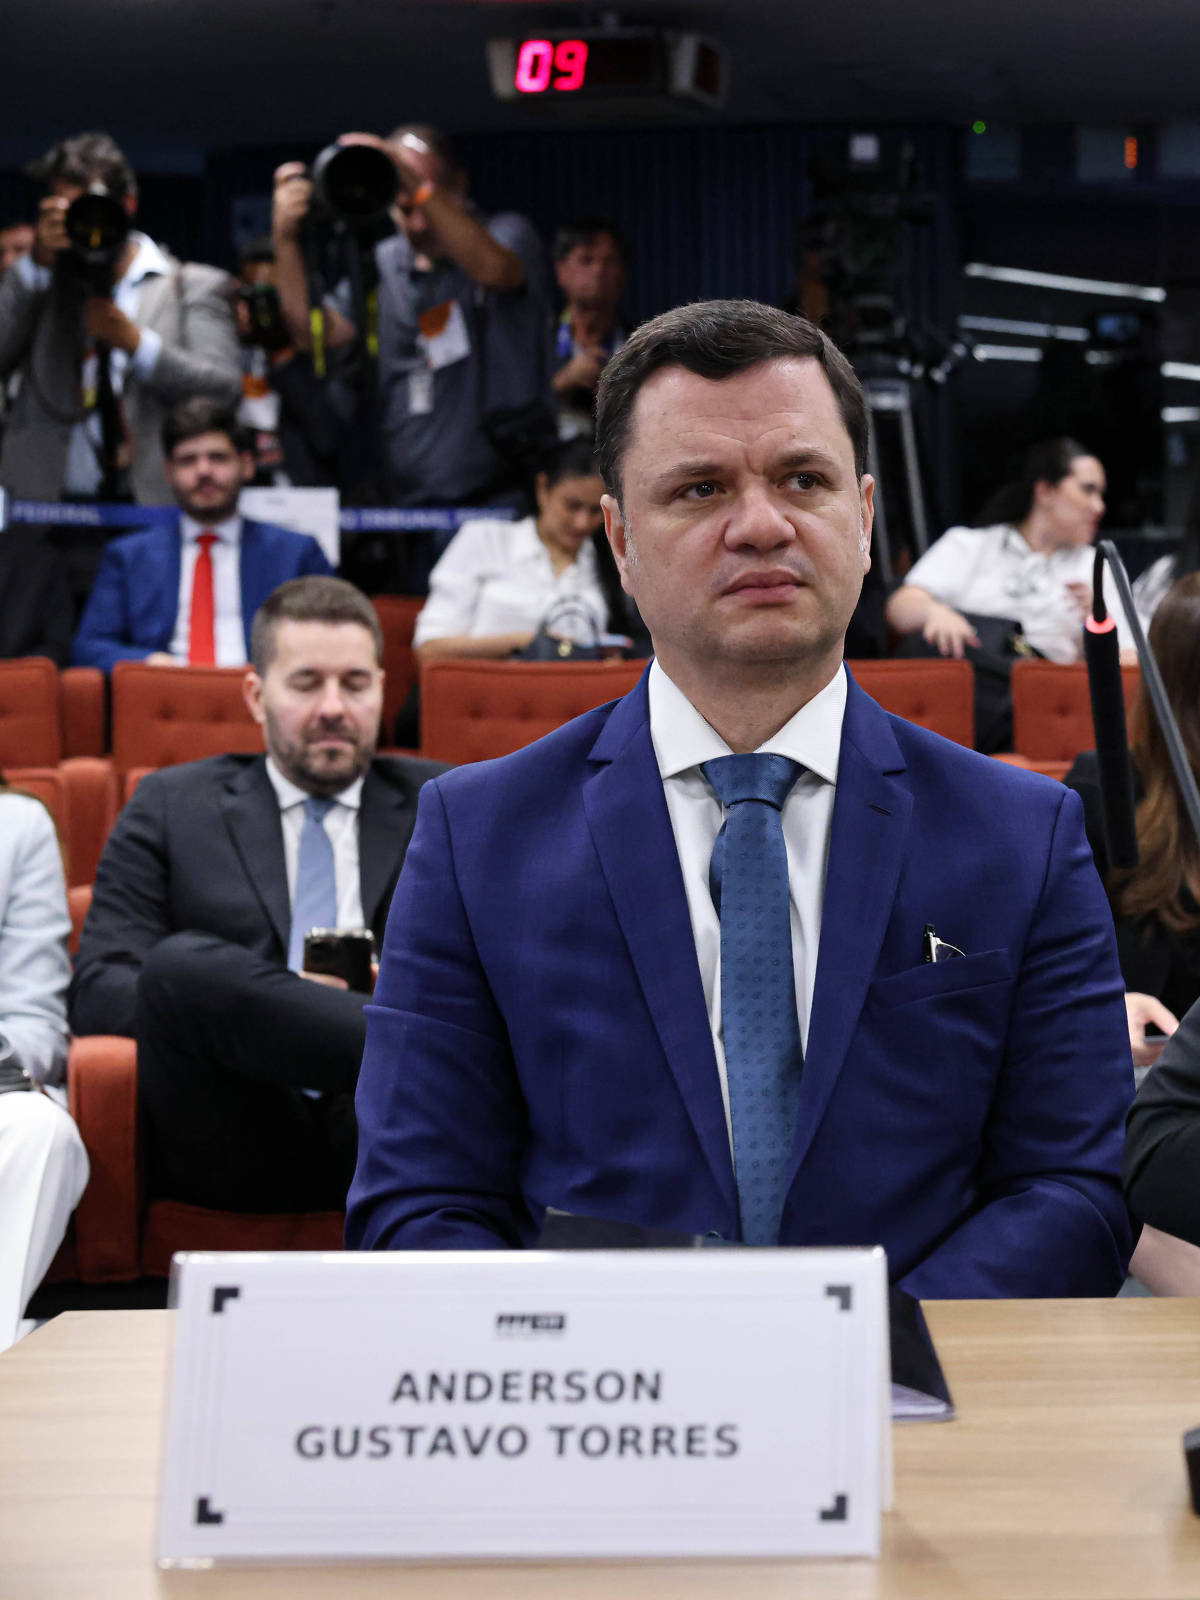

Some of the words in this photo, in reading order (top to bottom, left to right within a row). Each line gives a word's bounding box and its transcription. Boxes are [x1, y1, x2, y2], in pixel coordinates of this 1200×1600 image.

[515, 40, 588, 92] 09
[391, 1370, 662, 1403] ANDERSON
[295, 1425, 529, 1460] GUSTAVO
[549, 1425, 739, 1459] TORRES
